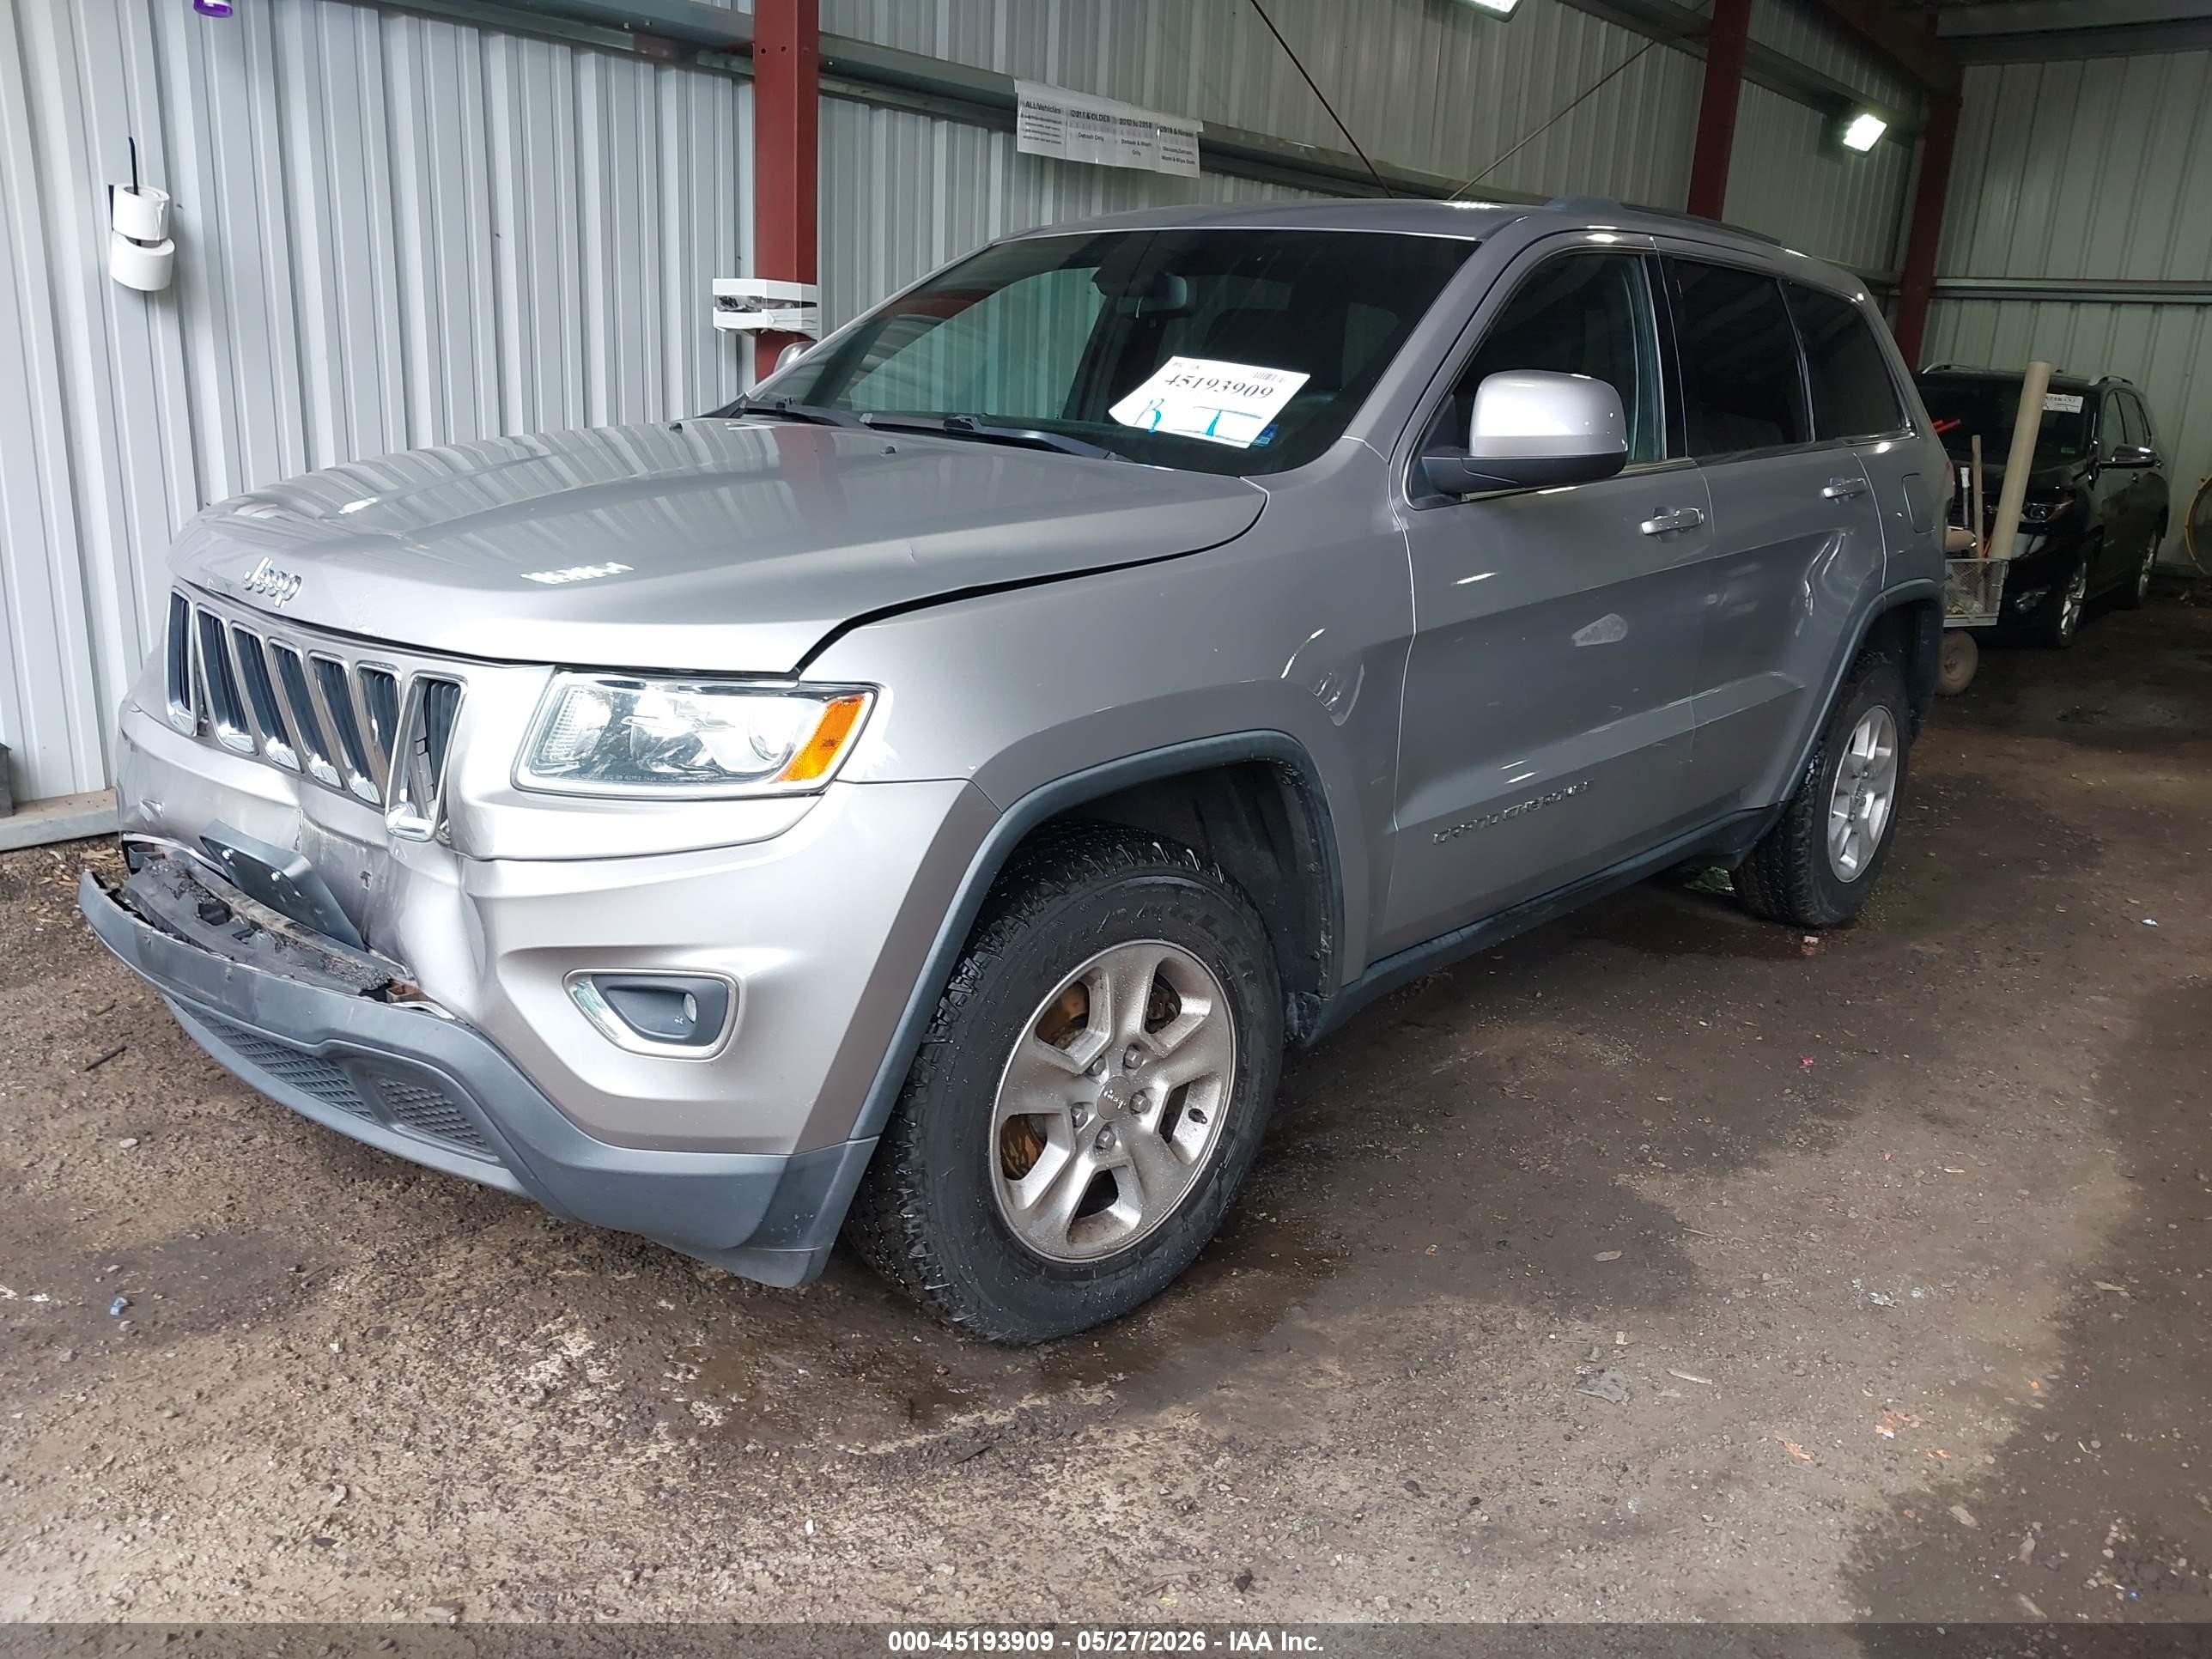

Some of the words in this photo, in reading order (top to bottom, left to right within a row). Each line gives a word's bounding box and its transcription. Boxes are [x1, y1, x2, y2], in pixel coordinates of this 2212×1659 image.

[1025, 100, 1037, 110] ALL
[1037, 102, 1061, 114] Vehicles
[1091, 112, 1110, 123] OLDER
[1164, 374, 1274, 398] 45193909
[244, 556, 303, 608] Jeep
